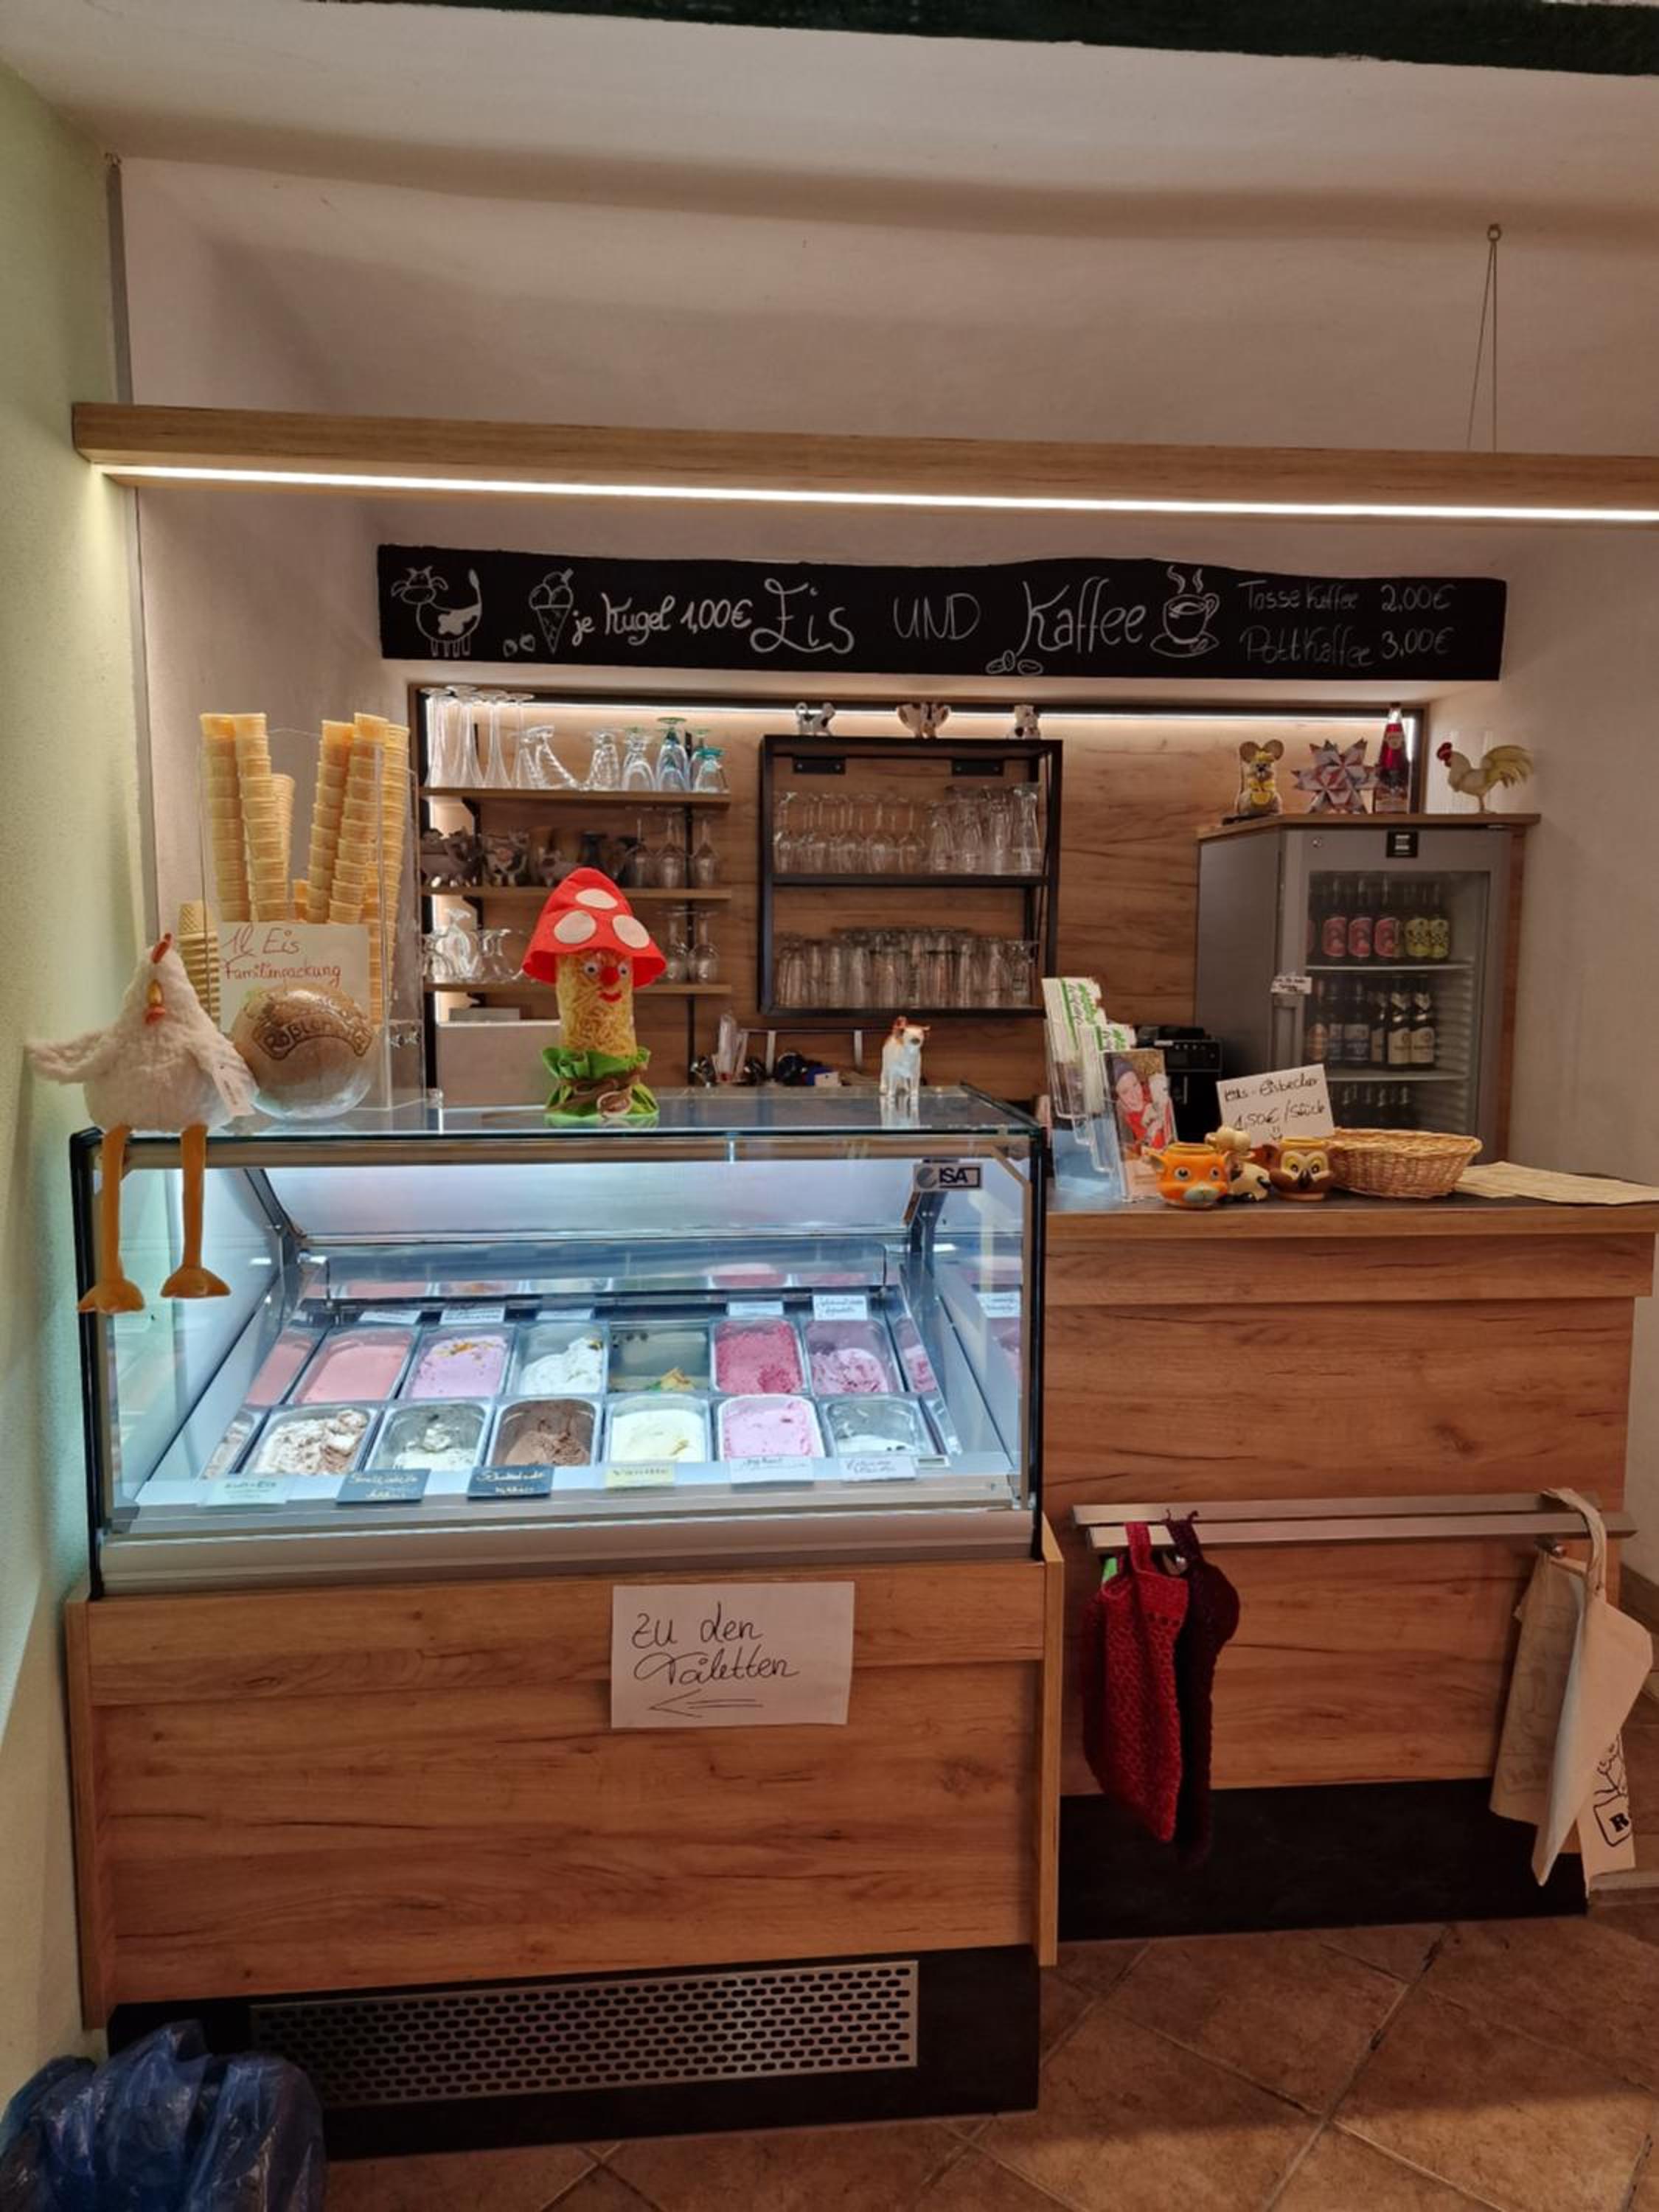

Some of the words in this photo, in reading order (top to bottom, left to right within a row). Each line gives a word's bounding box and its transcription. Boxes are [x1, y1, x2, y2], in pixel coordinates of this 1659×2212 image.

[1238, 579, 1301, 611] Tasse
[1304, 583, 1360, 611] Kaffee
[571, 609, 596, 647] je
[600, 592, 676, 646] Kugel
[679, 598, 754, 634] 1,00€
[749, 577, 855, 654] Eis
[893, 592, 981, 641] UND
[1015, 576, 1147, 657] Kaffee
[1303, 624, 1377, 667] Kaffee
[262, 926, 300, 955] Eis
[939, 1167, 968, 1183] ISA
[700, 1600, 763, 1644] den
[633, 1644, 800, 1686] Toiletten
